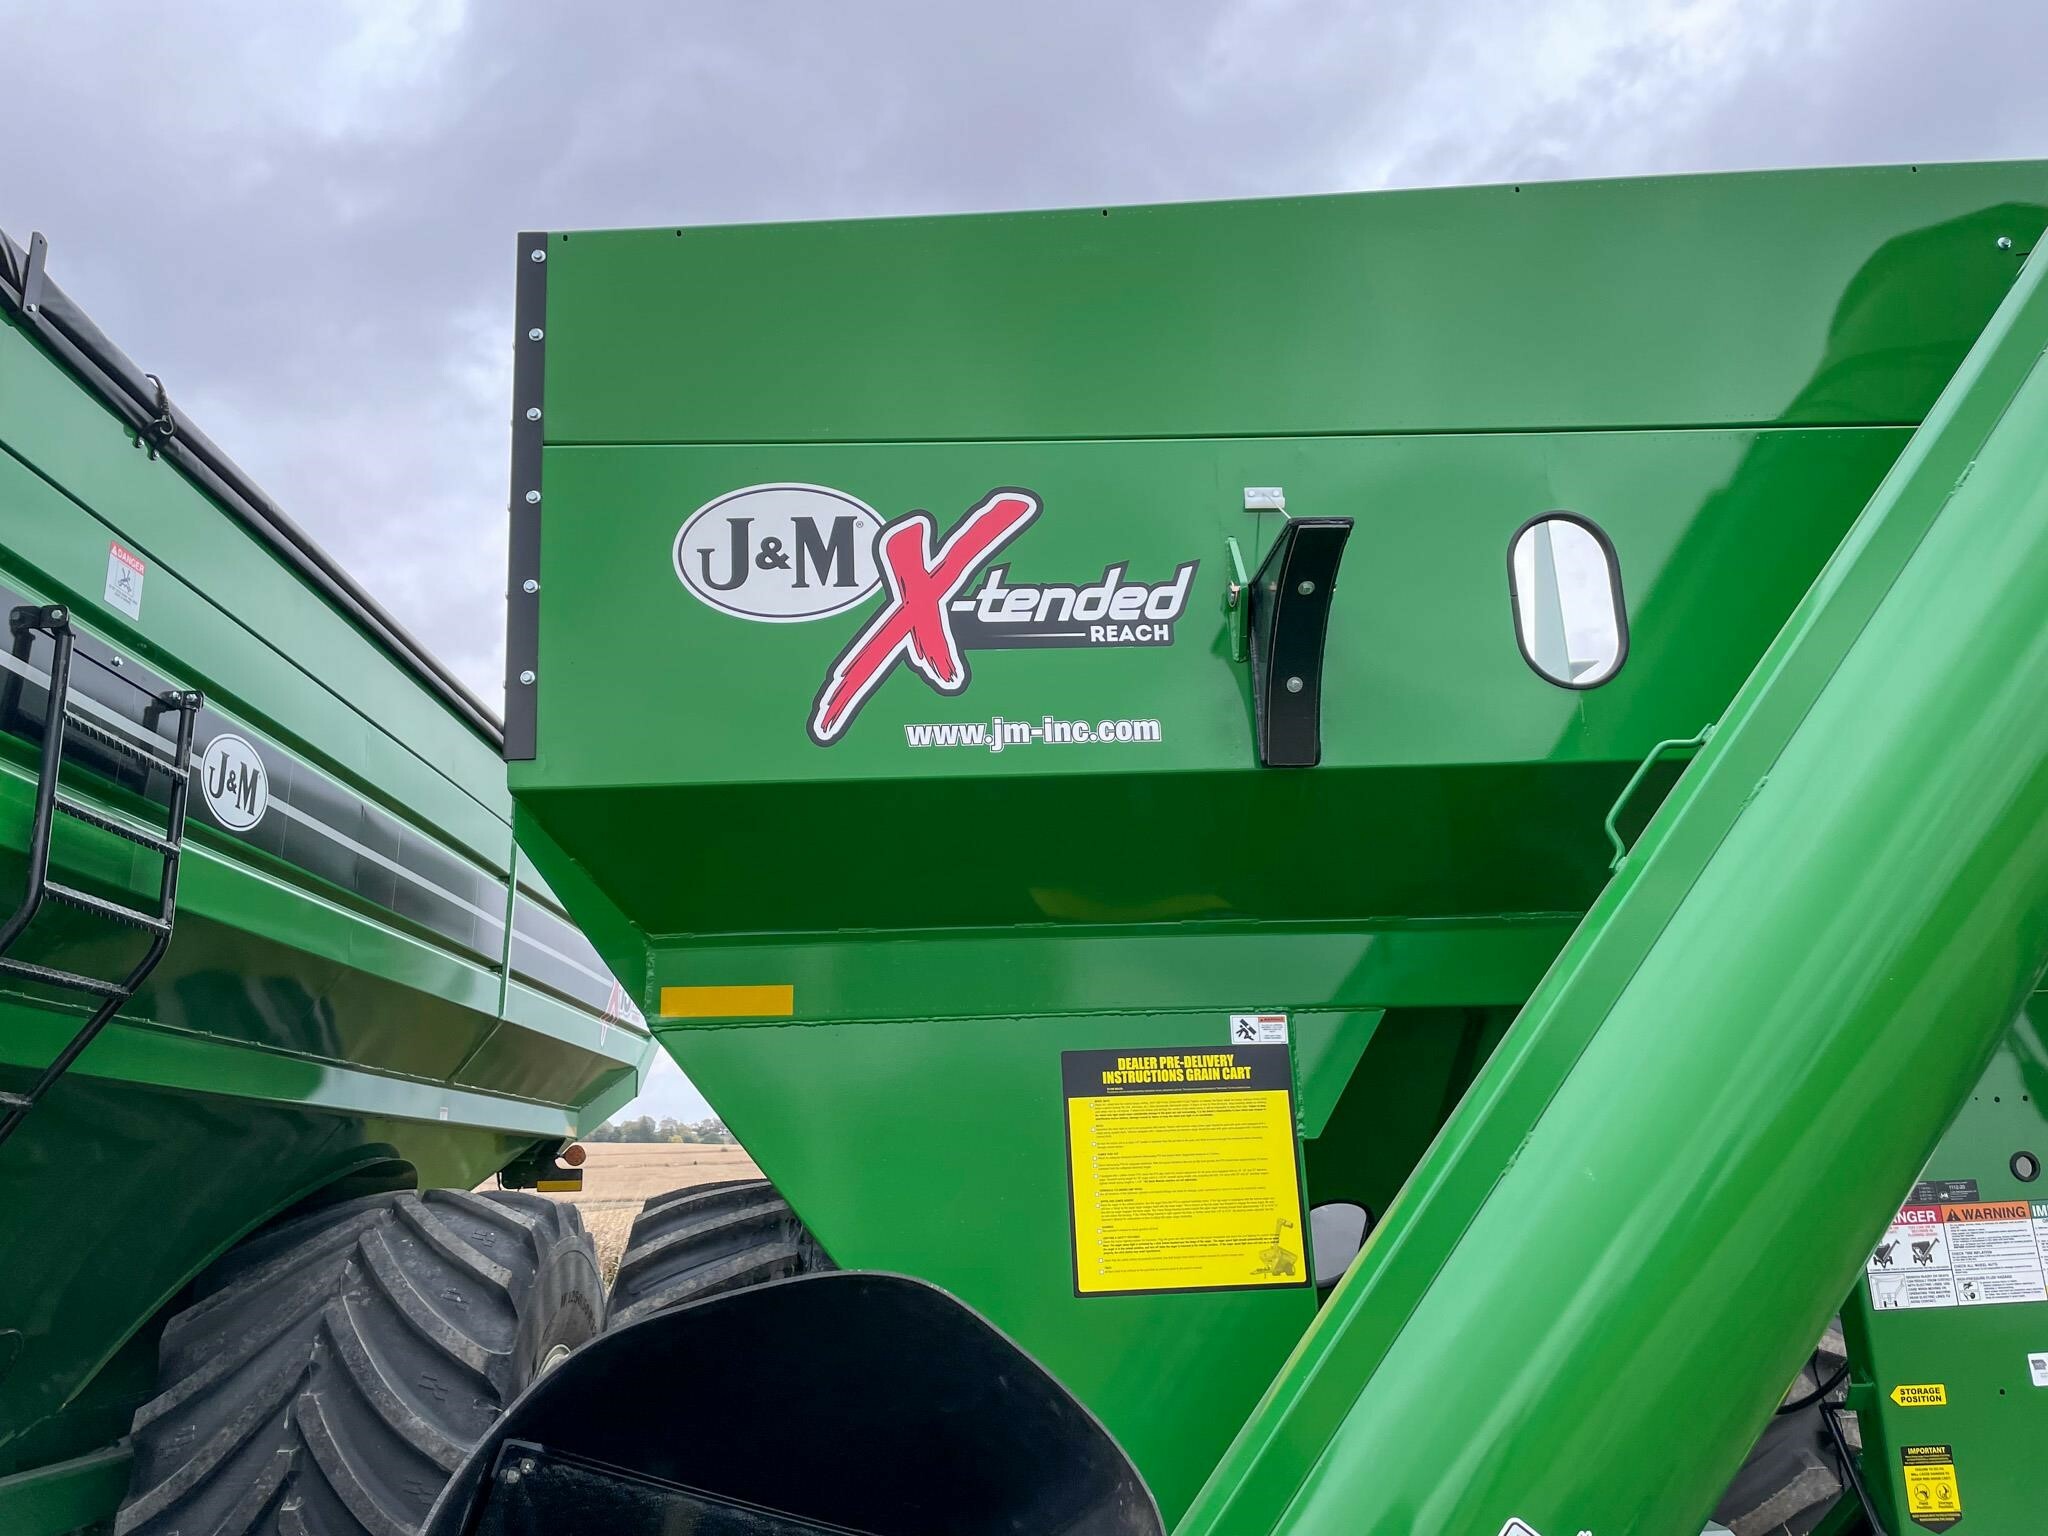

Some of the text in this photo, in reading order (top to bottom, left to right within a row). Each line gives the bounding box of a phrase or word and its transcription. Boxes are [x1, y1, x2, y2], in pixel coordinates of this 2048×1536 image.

[1090, 625, 1170, 643] REACH
[905, 716, 1162, 752] www.jm-inc.com
[1117, 1054, 1234, 1071] DEALER PRE-DELIVERY
[1102, 1066, 1251, 1084] INSTRUCTIONS GRAIN CART
[1961, 1206, 2027, 1221] WARNING
[1900, 1387, 1941, 1396] STORAGE
[1900, 1395, 1942, 1403] POSITION
[1907, 1446, 1946, 1455] IMPORTANT
